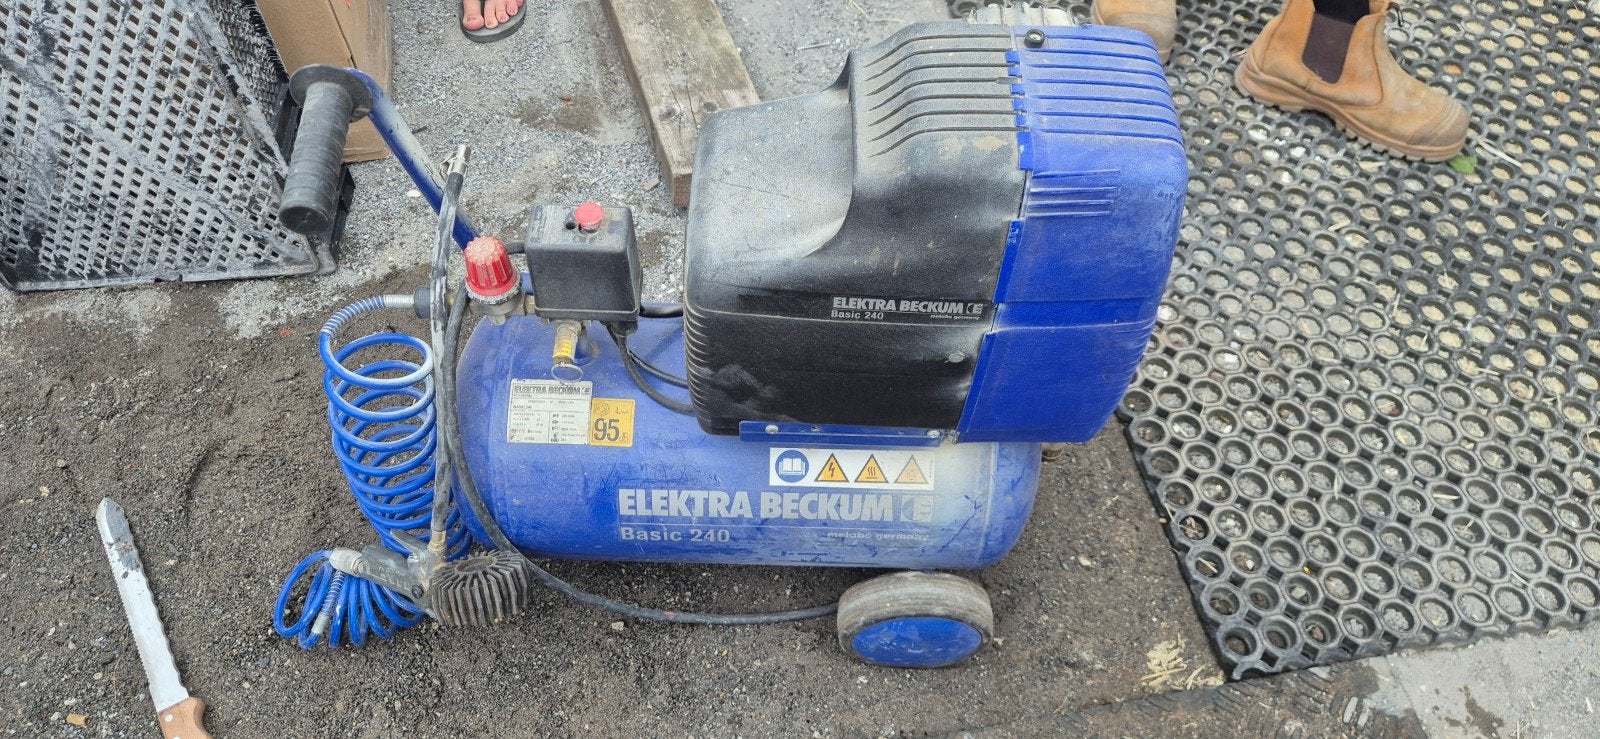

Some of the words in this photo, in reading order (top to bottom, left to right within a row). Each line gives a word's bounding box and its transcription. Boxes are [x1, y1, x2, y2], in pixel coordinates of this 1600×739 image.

[833, 296, 897, 311] ELEKTRA
[899, 299, 964, 314] BECKUM
[830, 309, 861, 319] Basic
[864, 311, 884, 320] 240
[514, 385, 547, 394] ELEKTRA
[594, 418, 620, 442] 95
[619, 431, 629, 443] dB
[618, 488, 754, 520] ELEKTRA
[760, 491, 894, 522] BECKUM
[621, 526, 682, 543] Basic
[690, 528, 730, 543] 240
[826, 531, 872, 541] metabo
[875, 532, 931, 543] germany
